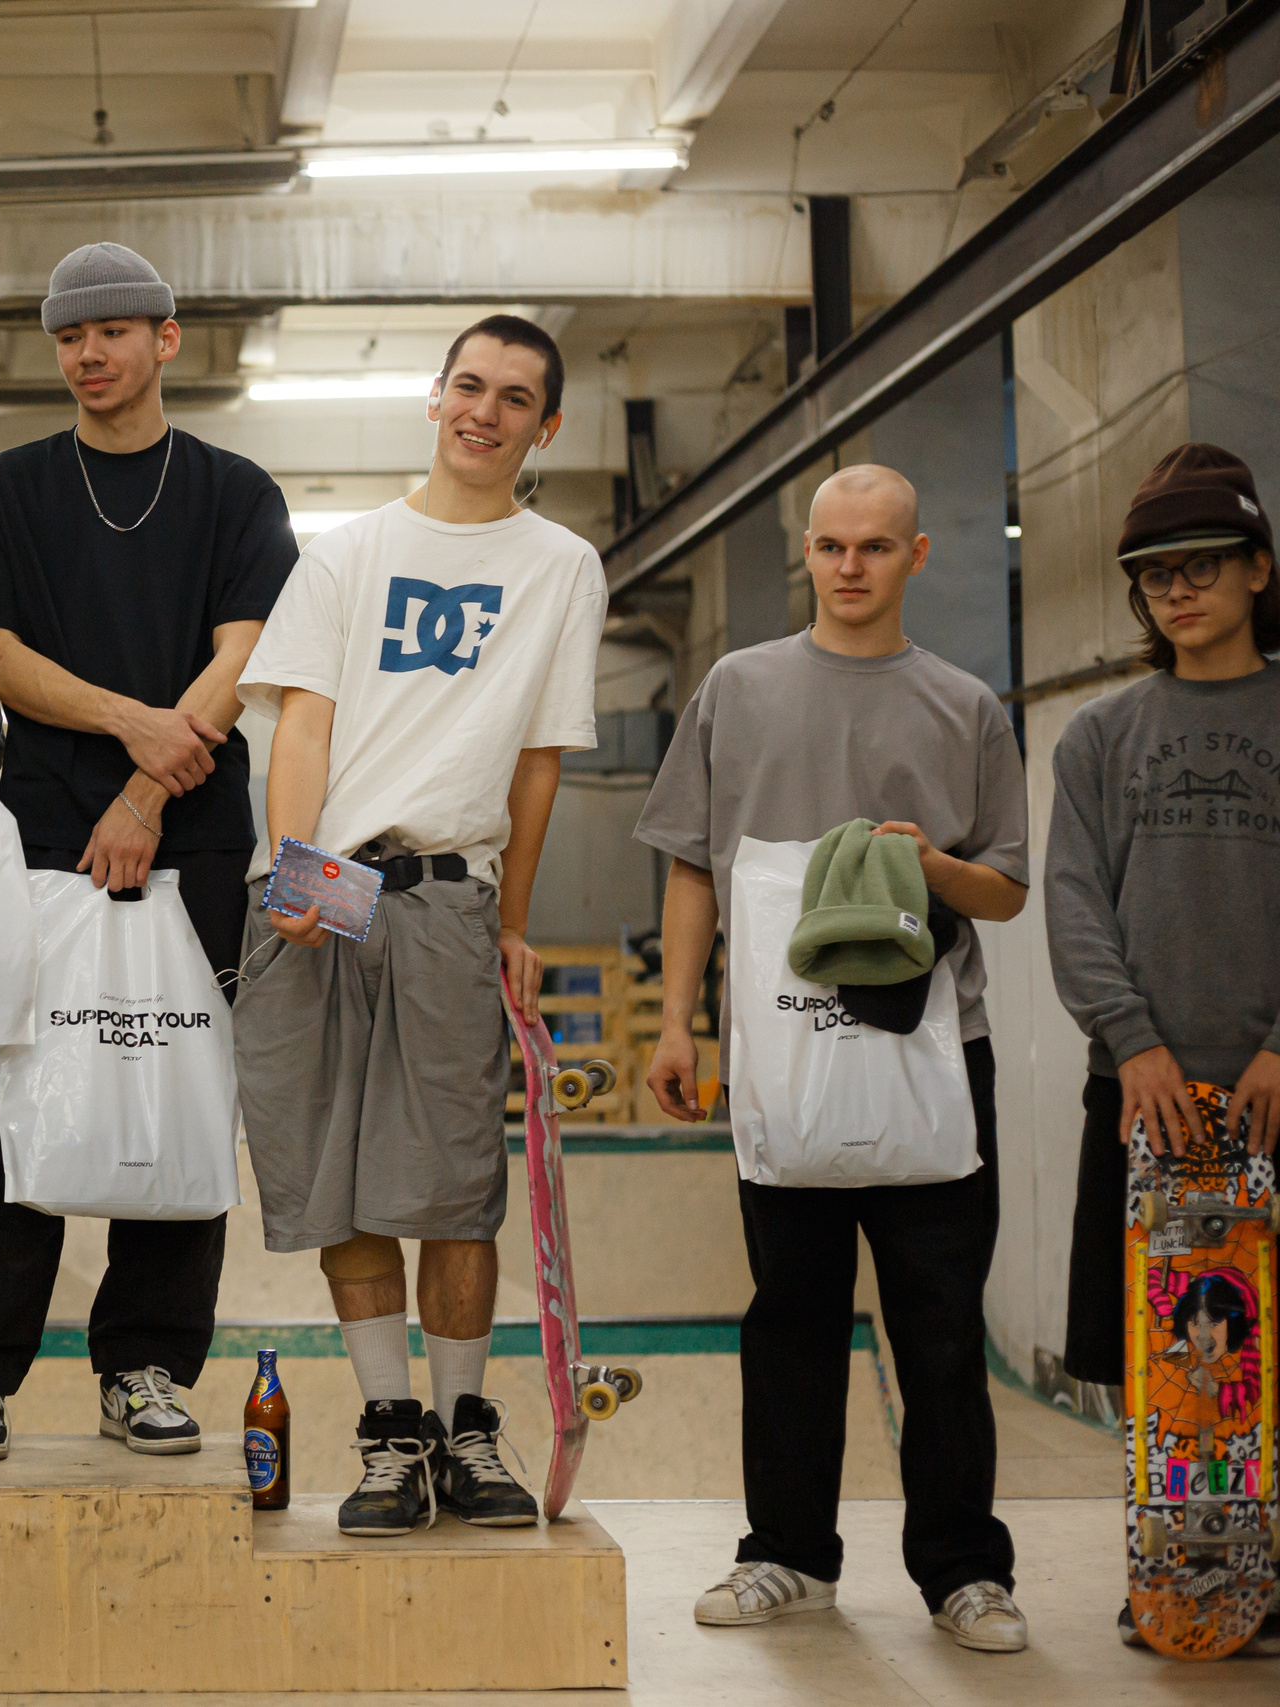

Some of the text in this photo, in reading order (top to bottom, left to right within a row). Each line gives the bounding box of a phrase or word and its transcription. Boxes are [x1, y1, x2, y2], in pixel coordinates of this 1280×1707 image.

[379, 576, 504, 676] DC
[1124, 735, 1190, 800] START
[50, 1009, 211, 1029] SUPPORT YOUR
[815, 1011, 859, 1031] LOC
[99, 1028, 168, 1048] LOCAL
[250, 1460, 258, 1470] 3
